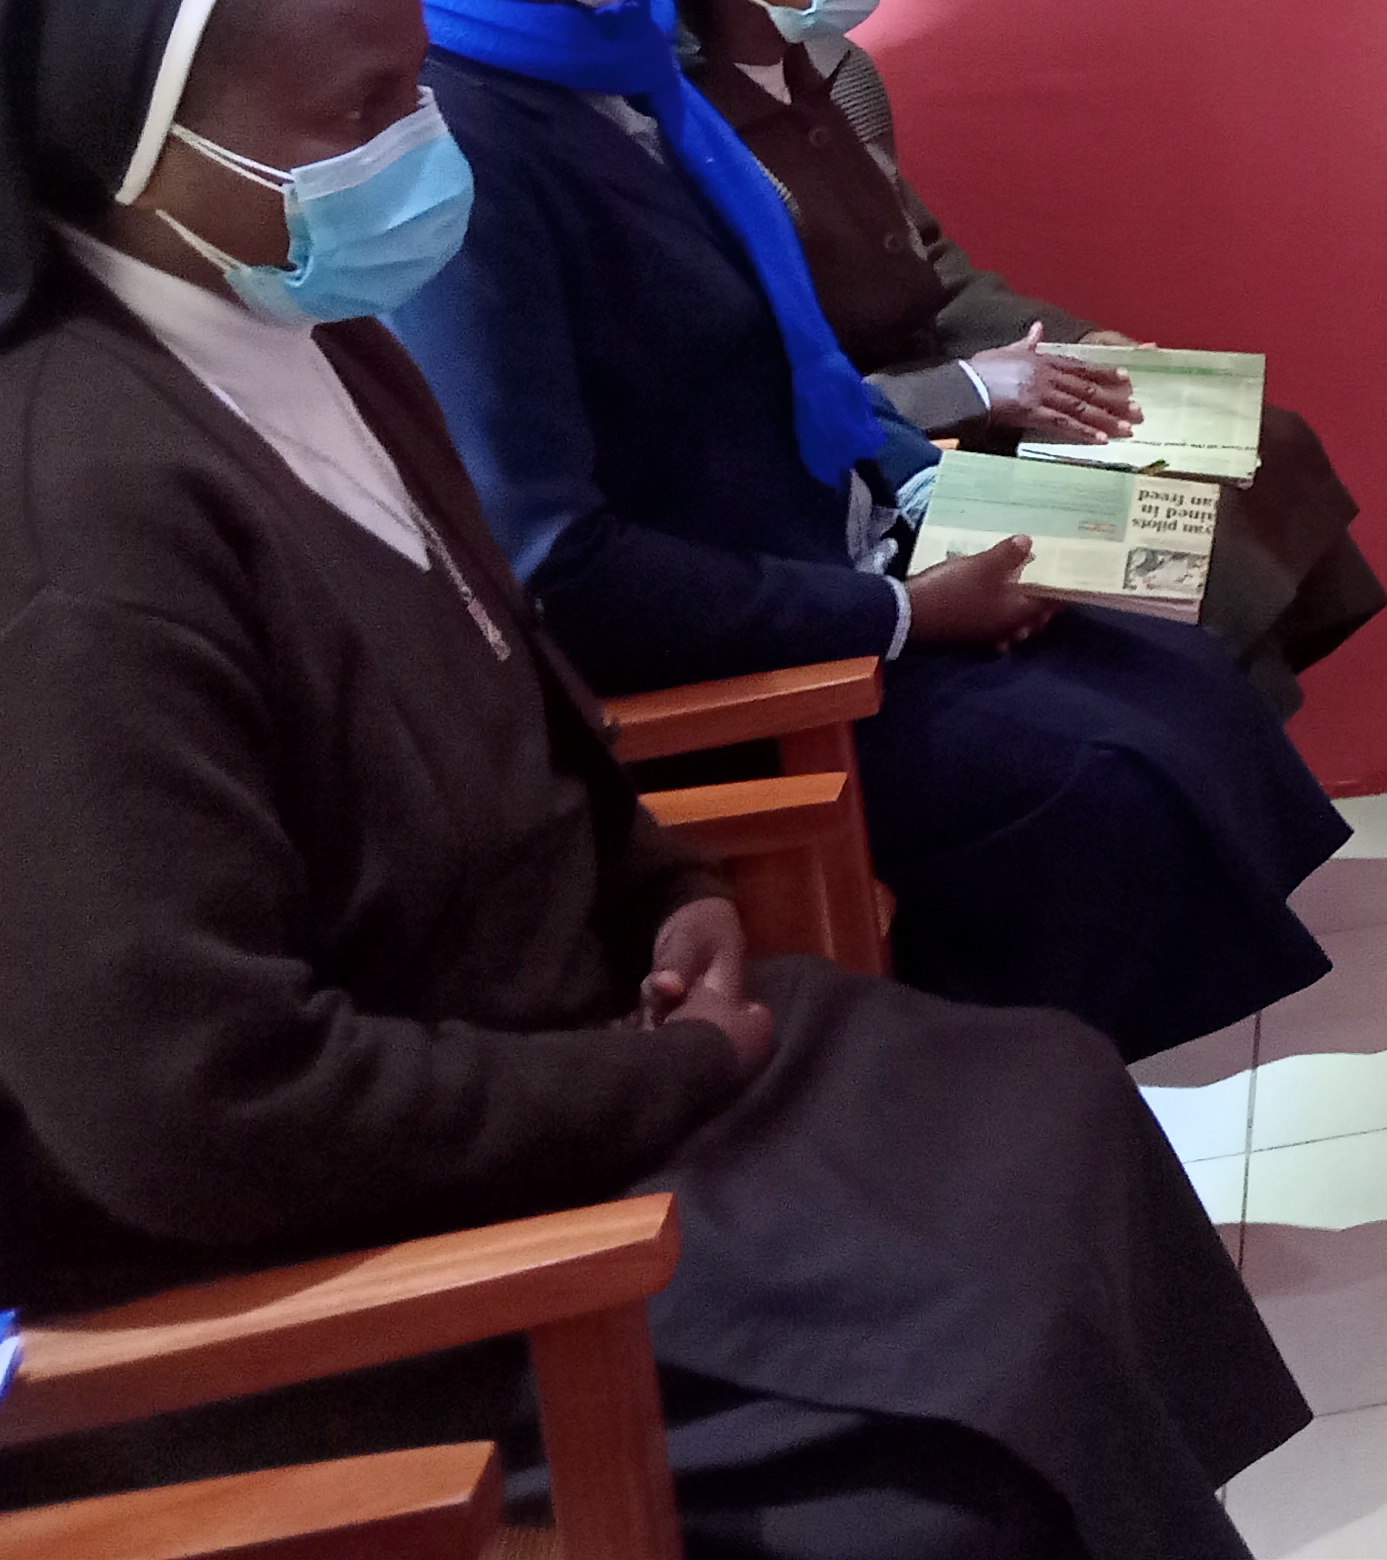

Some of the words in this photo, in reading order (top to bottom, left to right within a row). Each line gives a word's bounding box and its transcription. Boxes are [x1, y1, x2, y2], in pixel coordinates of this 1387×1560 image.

[1138, 489, 1184, 506] freed
[1141, 504, 1160, 518] in
[1131, 518, 1178, 532] pilots
